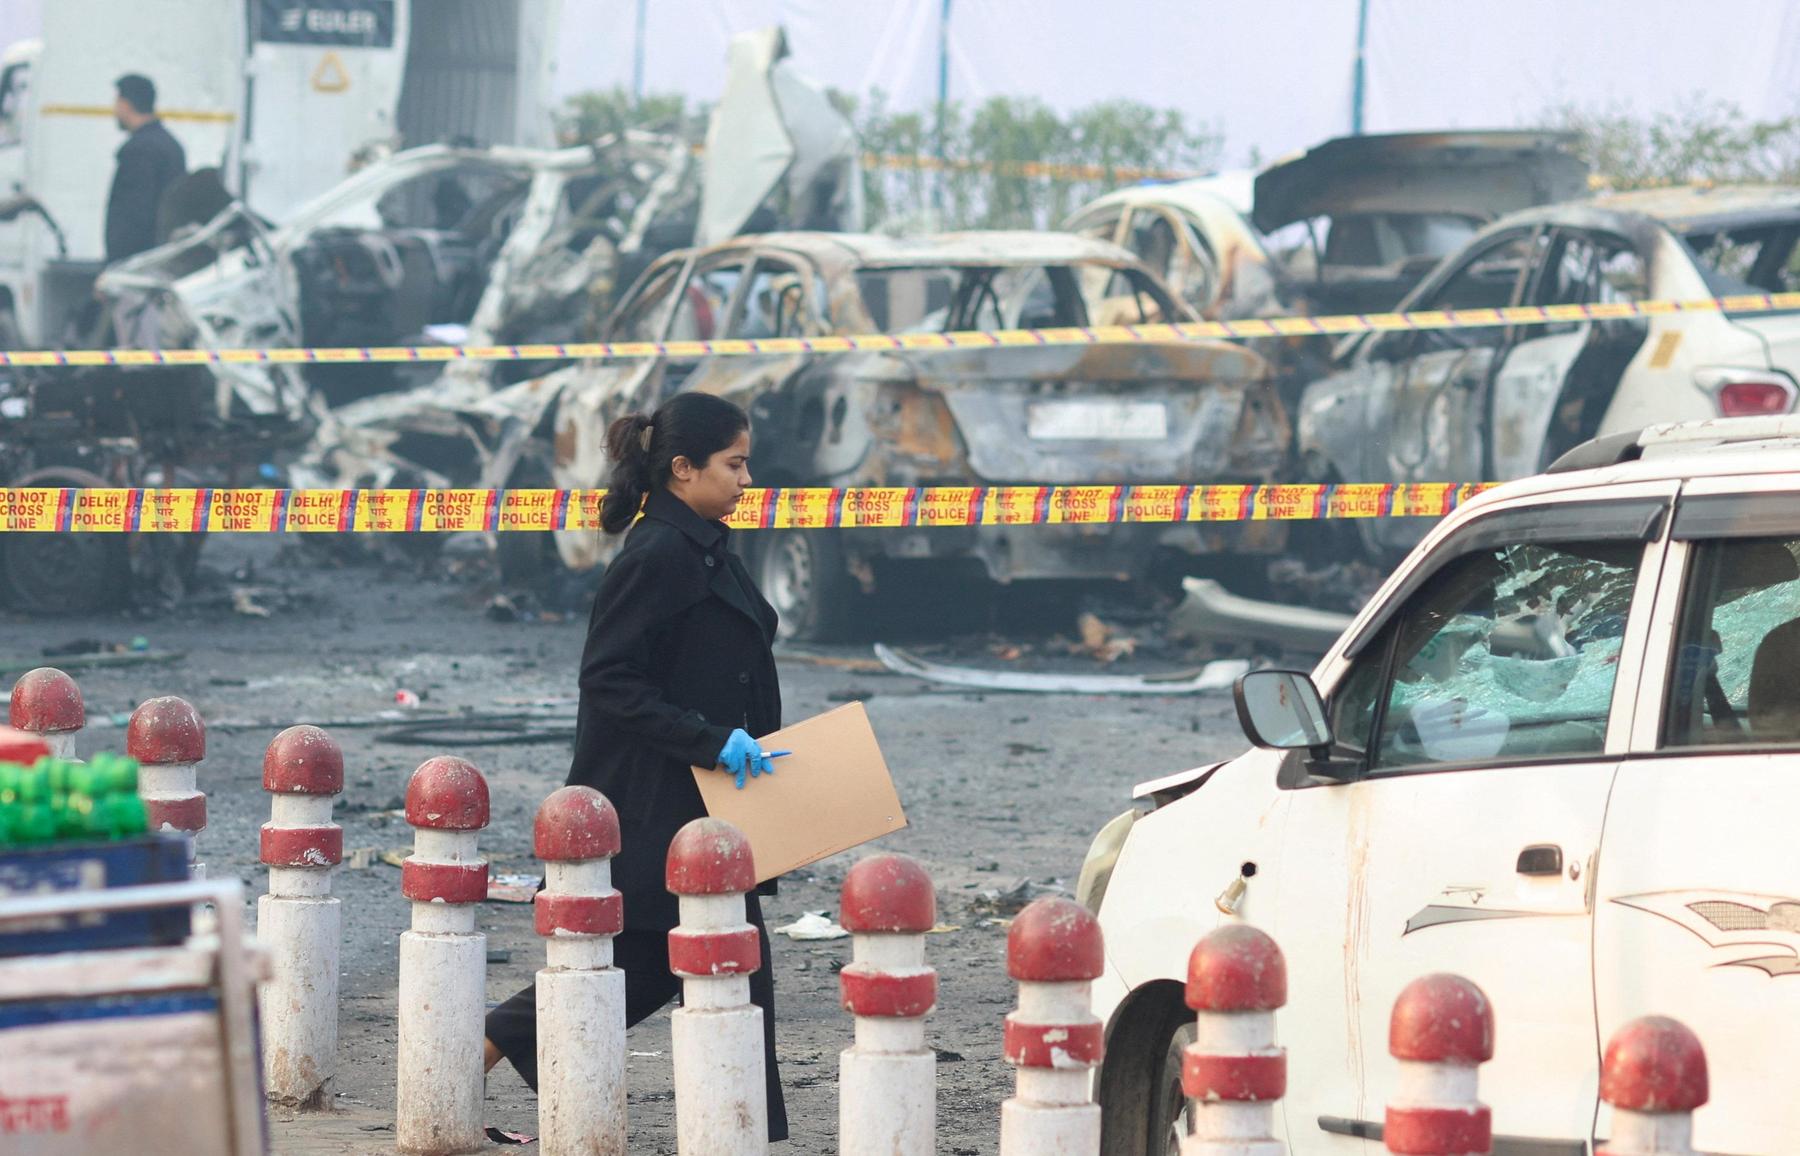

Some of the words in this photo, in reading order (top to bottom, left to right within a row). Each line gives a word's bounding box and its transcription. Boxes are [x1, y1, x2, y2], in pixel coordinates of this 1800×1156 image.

[0, 492, 16, 503] DO
[20, 492, 47, 503] NOT
[214, 493, 231, 503] DO
[235, 493, 262, 503] NOT
[427, 493, 445, 503] DO
[449, 493, 476, 503] NOT
[847, 491, 864, 500] DO
[868, 491, 896, 500] NOT
[925, 494, 963, 502] DELHI
[1075, 489, 1102, 497] NOT
[79, 497, 118, 507] DELHI
[294, 497, 332, 507] DELHI
[506, 496, 545, 507] DELHI
[1055, 499, 1096, 509] CROSS
[1260, 495, 1301, 504] CROSS
[0, 505, 43, 516] CROSS
[215, 505, 258, 516] CROSS
[428, 505, 471, 516] CROSS
[848, 501, 890, 511] CROSS
[1127, 505, 1171, 516] POLICE
[1331, 502, 1375, 512] POLICE
[920, 509, 965, 519] POLICE
[1062, 512, 1090, 521] LINE
[1267, 507, 1295, 517] LINE
[6, 518, 36, 529] LINE
[75, 514, 122, 525] POLICE
[223, 518, 251, 529] LINE
[289, 514, 335, 525] POLICE
[436, 518, 464, 529] LINE
[502, 513, 547, 524] POLICE
[855, 514, 883, 524] LINE
